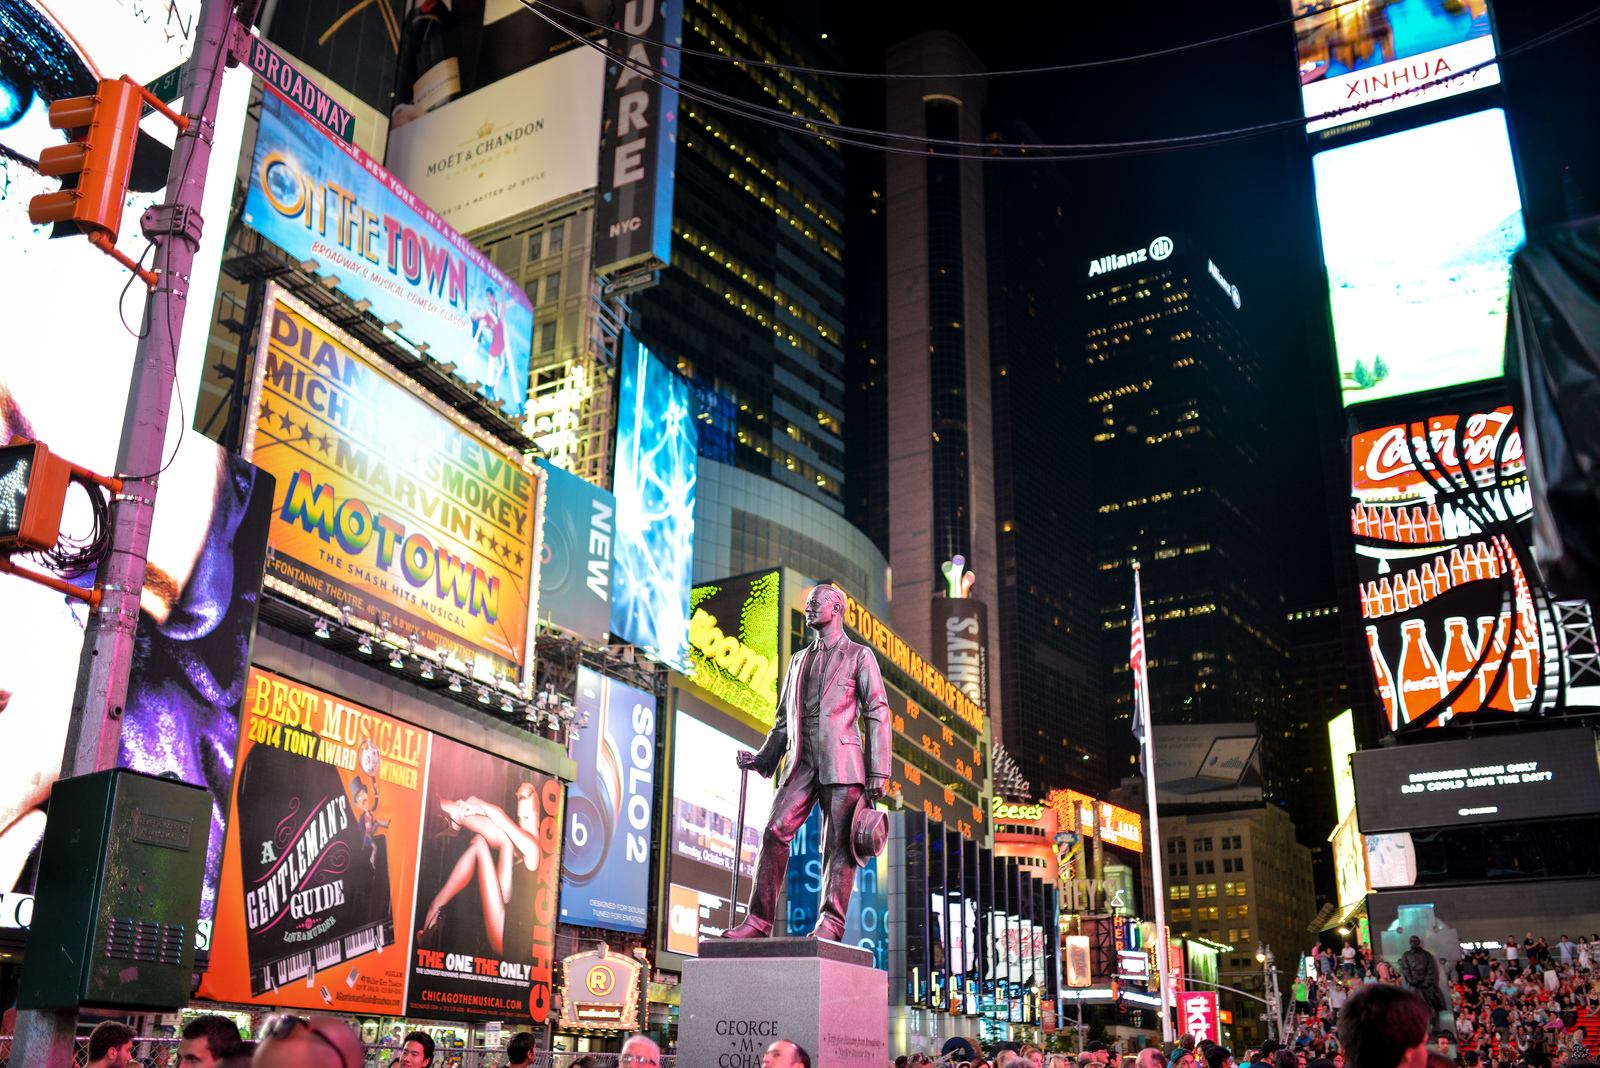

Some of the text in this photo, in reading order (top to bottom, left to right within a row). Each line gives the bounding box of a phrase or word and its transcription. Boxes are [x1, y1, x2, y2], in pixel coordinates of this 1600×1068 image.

[163, 72, 176, 89] ST
[254, 43, 350, 137] BROADWAY
[1346, 57, 1452, 99] XINHUA
[364, 159, 388, 181] NEW
[426, 118, 546, 177] MOËT & CHANDON
[507, 181, 518, 192] OF
[520, 170, 547, 187] STYLE
[260, 151, 469, 313] ON THE TOWN
[609, 217, 641, 239] NYC
[311, 240, 370, 279] BROADWAY'S
[370, 272, 405, 298] MUSICAL
[406, 290, 439, 314] COMEDY
[1088, 248, 1148, 278] Allianz
[270, 309, 373, 397] DIAN
[334, 439, 472, 540] MARVIN
[443, 425, 532, 502] TEVIE
[423, 452, 528, 536] SMOKEY
[280, 468, 501, 625] MOTOWN
[586, 499, 613, 601] NEW
[319, 548, 466, 628] THE SMASH HITS MUSICAL
[856, 603, 872, 641] TO
[871, 618, 911, 673] RETURN
[910, 651, 924, 684] AS
[922, 661, 945, 701] HEAD
[944, 681, 958, 710] OF
[251, 674, 424, 768] BEST MUSICAL!
[247, 717, 420, 791] 2014 TONY AWARD WINNER
[1401, 783, 1425, 794] DAD
[1426, 779, 1465, 792] COULD
[1466, 776, 1496, 788] SAVE
[1496, 774, 1521, 785] THE
[246, 795, 348, 930] GENTLEMAN'S
[260, 840, 277, 864] A
[289, 879, 345, 921] GUIDE
[528, 780, 563, 1024] CHICAGO
[589, 898, 617, 911] DESIGNED
[616, 902, 629, 911] FOR
[282, 929, 302, 944] LOVE
[305, 915, 338, 941] MURDER
[416, 948, 531, 981] THE ONE THE ONLY
[421, 990, 523, 1010] CHICAGOTHEMUSICAL.COM
[1187, 996, 1211, 1047] tkts
[715, 1019, 779, 1038] GEORGE
[740, 1038, 755, 1053] M
